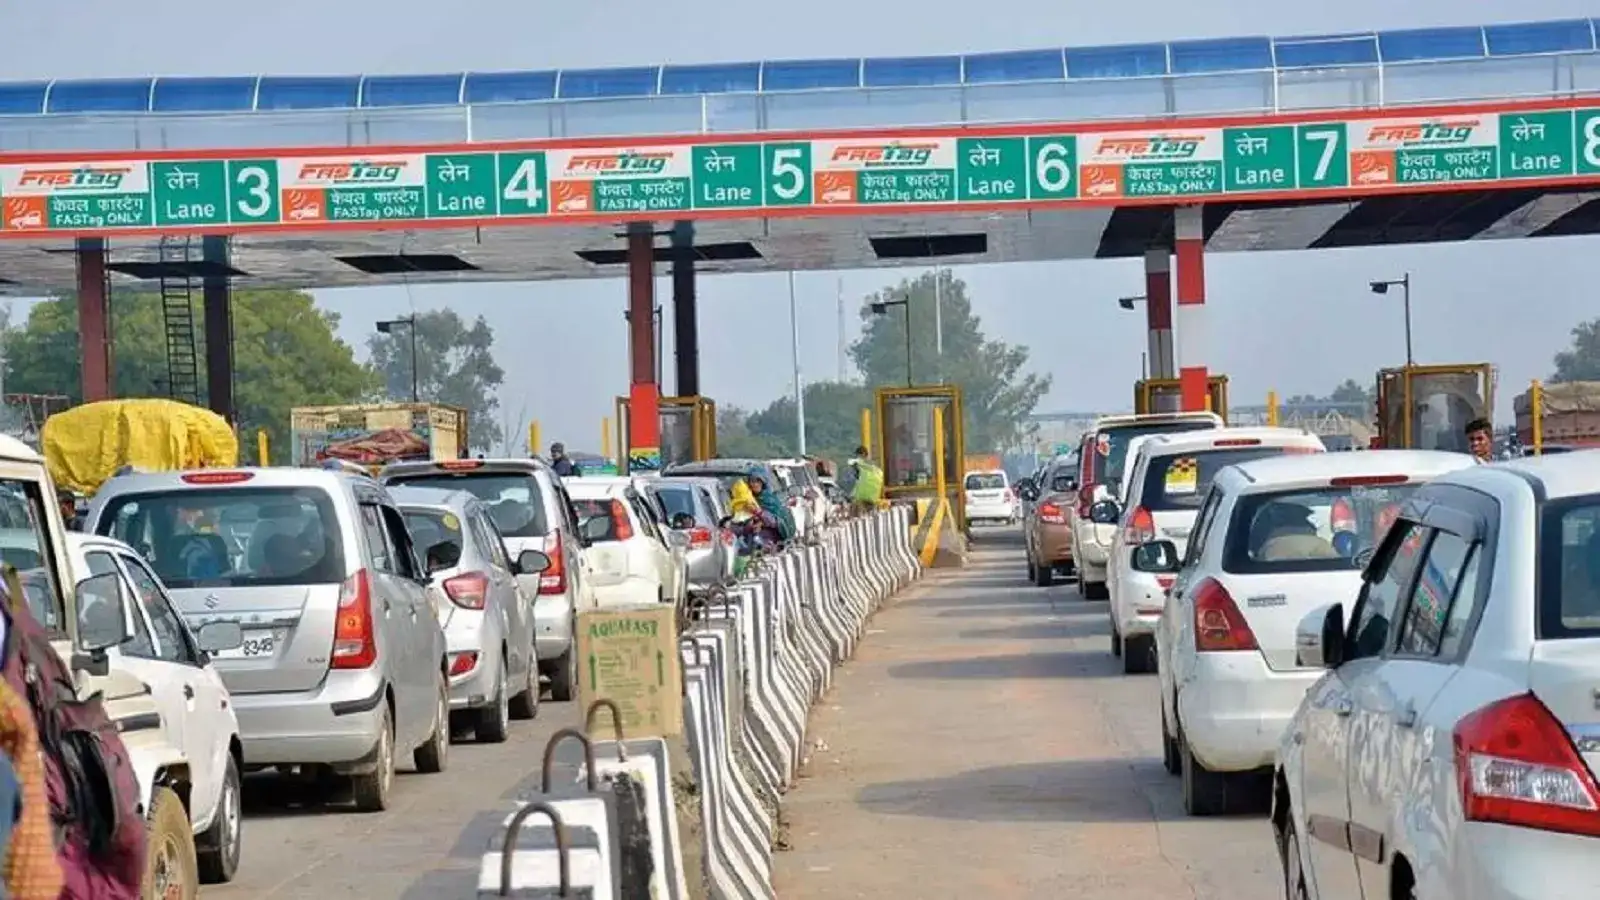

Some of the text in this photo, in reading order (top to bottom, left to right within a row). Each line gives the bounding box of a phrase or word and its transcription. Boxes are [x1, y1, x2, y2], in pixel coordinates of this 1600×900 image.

[1511, 119, 1545, 141] लेन
[1235, 134, 1268, 156] लेन
[704, 150, 735, 172] लेन
[969, 143, 1000, 166] लेन
[1305, 131, 1339, 181] 7
[1400, 151, 1436, 168] केवल
[1511, 152, 1562, 171] Lane
[438, 159, 470, 181] लेन
[772, 148, 805, 199] 5
[1037, 143, 1070, 191] 6
[1127, 166, 1163, 181] केवल
[1235, 167, 1285, 185] Lane
[1403, 165, 1489, 183] FASTag ONLY
[165, 166, 199, 189] लेन
[503, 159, 543, 208] 4
[861, 172, 897, 187] केवल
[968, 177, 1016, 195] Lane
[236, 166, 272, 217] 3
[330, 188, 366, 205] केवल
[599, 180, 632, 197] केवल
[703, 183, 752, 201] Lane
[864, 188, 948, 201] FASTag ONLY
[1130, 180, 1215, 195] FASTag ONLY
[53, 196, 88, 212] केवल
[166, 199, 216, 219] Lane
[437, 192, 486, 211] Lane
[601, 197, 684, 211] FASTag ONLY
[55, 212, 142, 227] FASTag ONLY
[334, 205, 417, 219] FASTag ONLY
